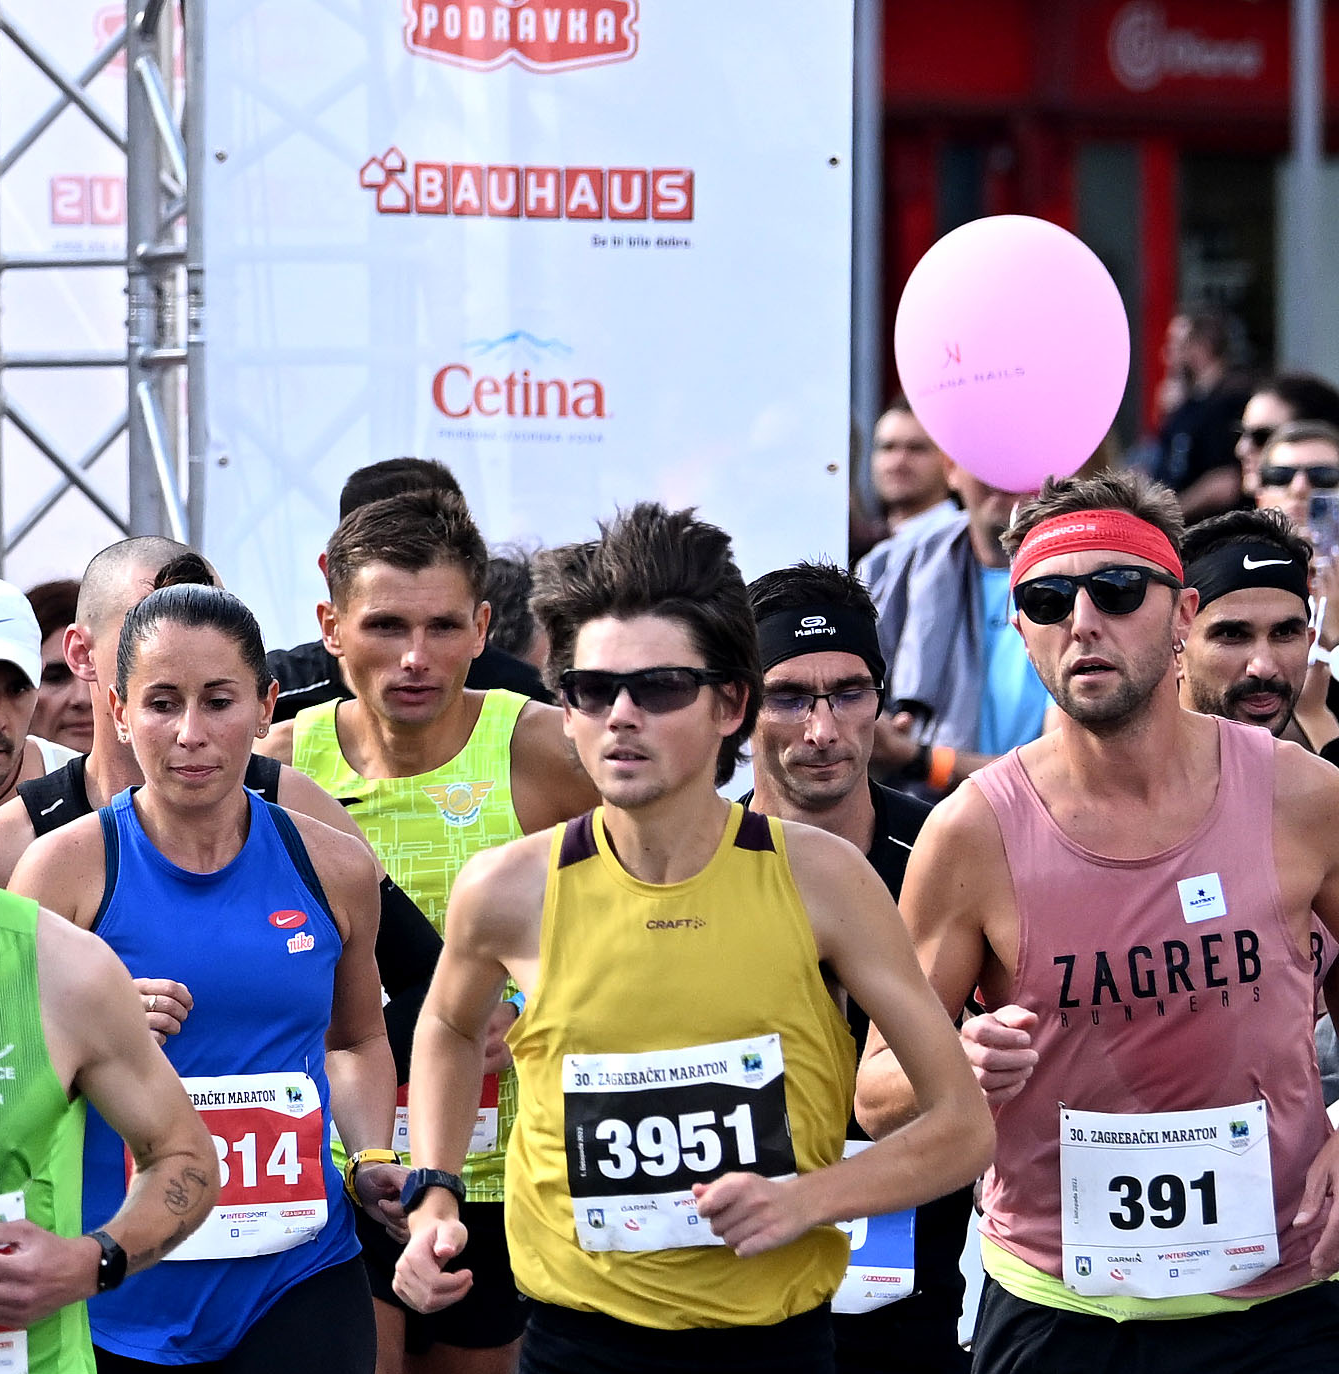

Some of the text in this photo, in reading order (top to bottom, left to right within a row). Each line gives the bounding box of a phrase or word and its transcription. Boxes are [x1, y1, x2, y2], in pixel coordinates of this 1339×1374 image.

[421, 4, 616, 44] PODRAVKA
[416, 165, 693, 217] BAUHAUS
[432, 362, 606, 419] Cetina
[646, 918, 693, 930] CRAFT
[288, 934, 313, 952] nike
[1054, 930, 1261, 1008] ZAGREB
[1061, 987, 1260, 1028] RUNNERS
[575, 1061, 728, 1086] 30. ZAGREBAČKI MARATON
[228, 1089, 276, 1104] MARATON
[595, 1103, 757, 1180] 3951
[1070, 1127, 1217, 1144] 30. ZAGREBAČKI MARATON
[621, 1201, 658, 1212] GARMIN
[1108, 1170, 1218, 1231] 391
[227, 1211, 268, 1219] INTERSPORT
[1108, 1253, 1142, 1263] GARMIN
[1164, 1250, 1211, 1260] INTERSPORT
